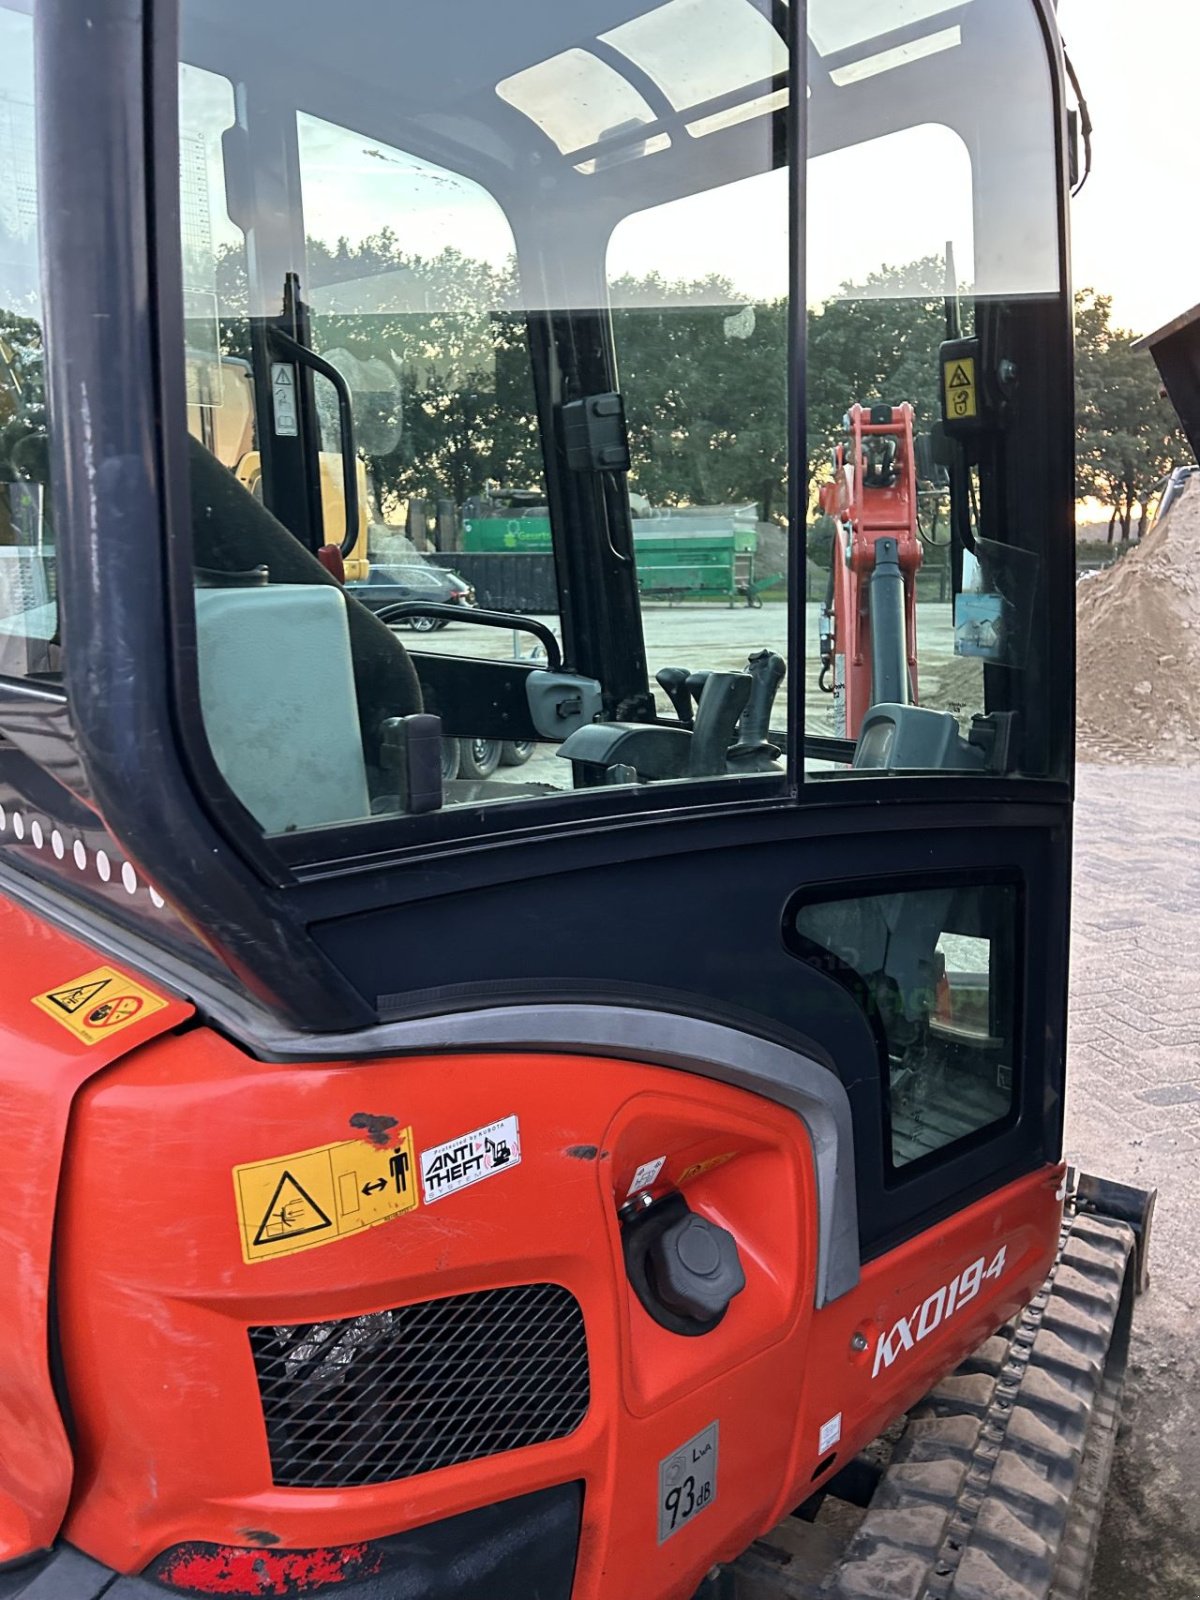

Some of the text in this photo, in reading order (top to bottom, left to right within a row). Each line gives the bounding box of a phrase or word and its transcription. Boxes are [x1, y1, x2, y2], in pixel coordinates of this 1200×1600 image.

[478, 1122, 504, 1137] KUBOTA
[425, 1143, 474, 1176] ANTI
[425, 1154, 484, 1190] THEFT
[871, 1244, 1007, 1379] KX019-4
